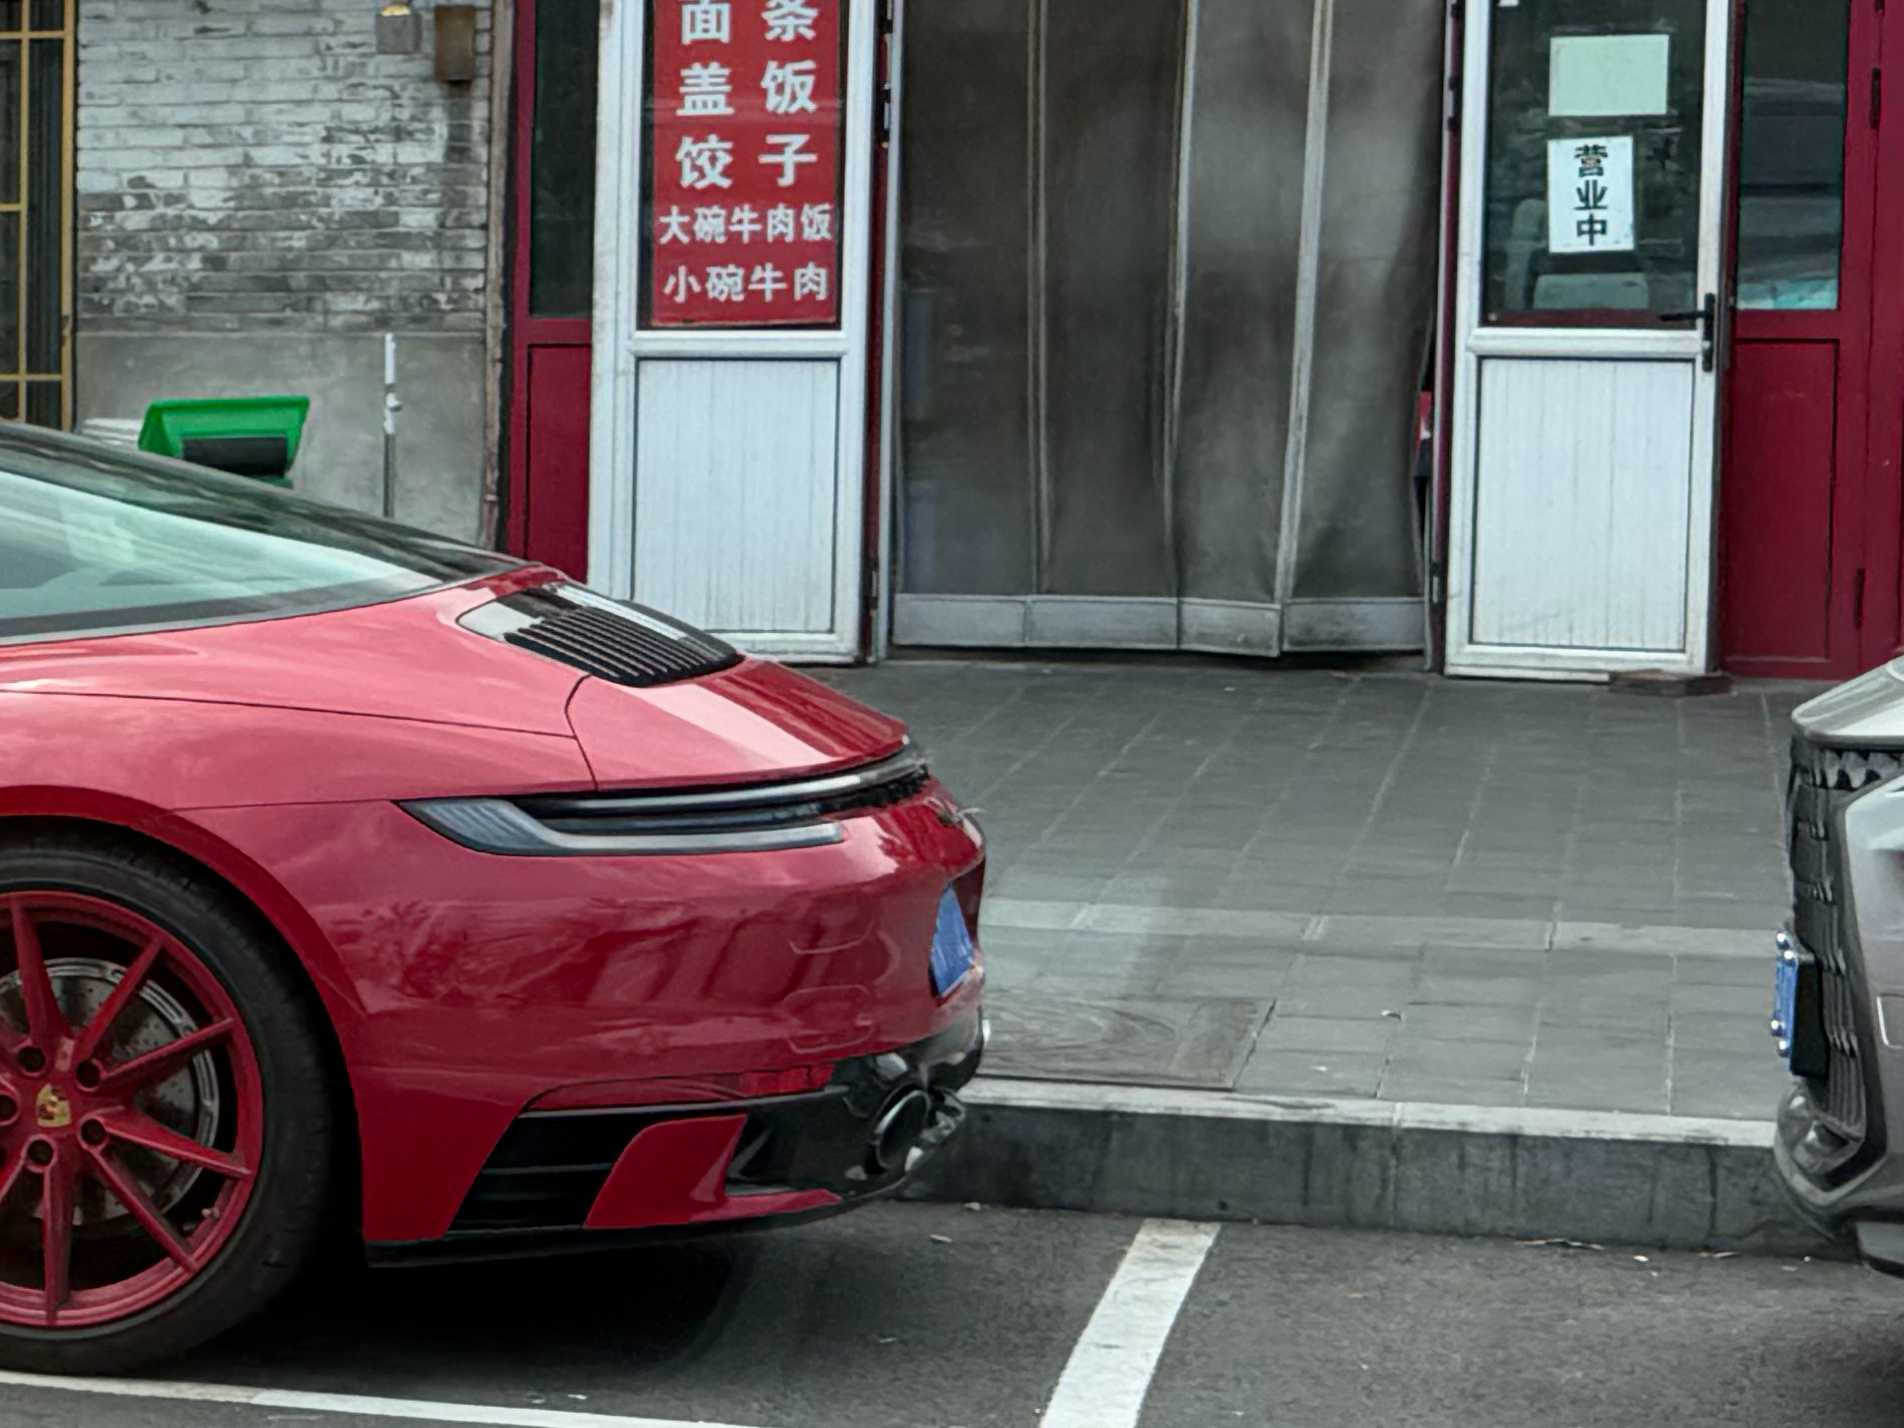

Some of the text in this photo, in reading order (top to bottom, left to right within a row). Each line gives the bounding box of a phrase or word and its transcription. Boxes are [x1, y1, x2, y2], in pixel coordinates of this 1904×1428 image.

[676, 59, 818, 117] 盖饭
[674, 133, 818, 190] 饺子
[658, 203, 834, 245] 大碗牛肉饭
[1574, 145, 1608, 247] 营业中
[662, 261, 829, 303] 小碗牛肉
